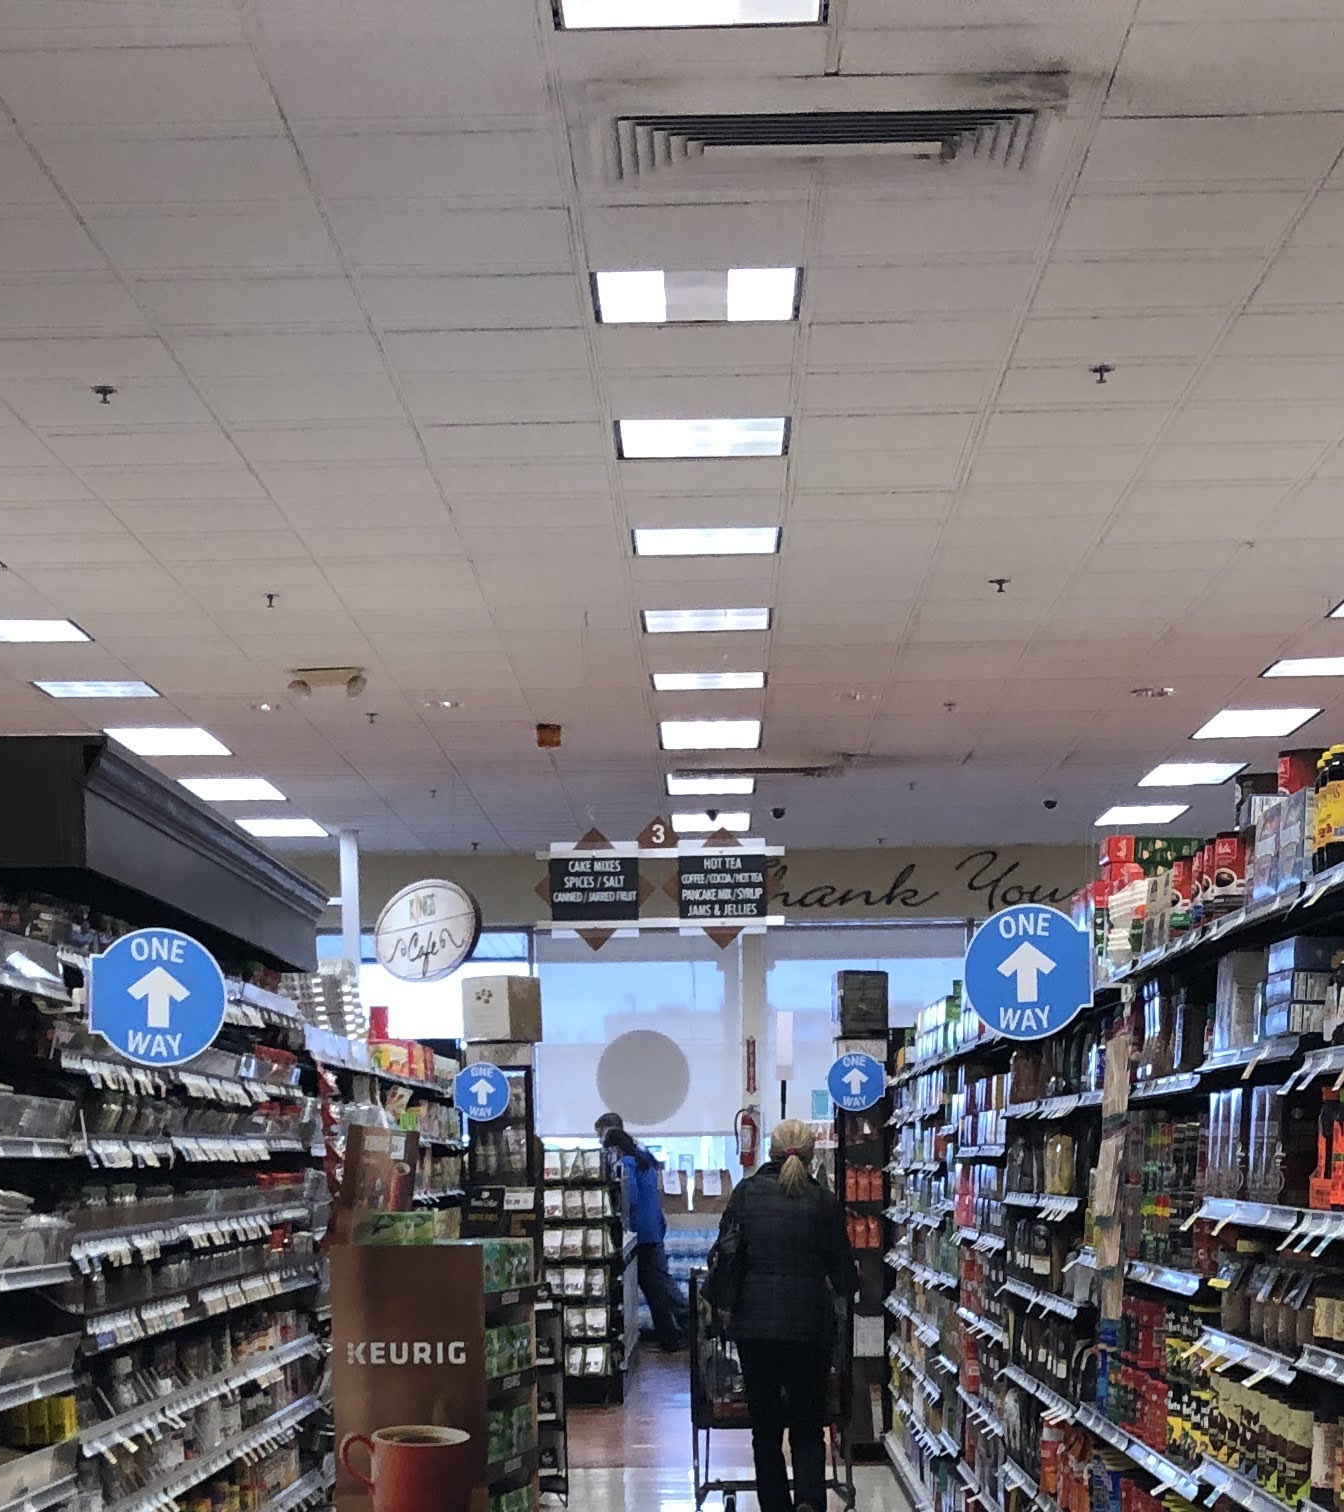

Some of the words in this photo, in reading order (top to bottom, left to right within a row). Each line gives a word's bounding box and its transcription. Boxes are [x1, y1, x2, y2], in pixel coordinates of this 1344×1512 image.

[651, 824, 665, 844] 3
[568, 860, 592, 873] CAKE
[594, 859, 621, 872] MIXES
[703, 858, 724, 870] HOT
[725, 857, 742, 869] TEA
[563, 876, 594, 889] SPICES
[603, 875, 624, 888] SALT
[681, 873, 705, 884] COFFEE
[956, 850, 1078, 913] You
[552, 891, 582, 903] CANNED
[616, 890, 637, 901] FRUIT
[681, 888, 716, 900] PANCAKE
[717, 889, 732, 900] MIX
[737, 887, 763, 899] SYRUP
[687, 904, 712, 917] JAMS
[714, 904, 721, 915] &
[723, 903, 757, 916] JELLIES
[999, 912, 1052, 939] ONE
[130, 936, 188, 964] ONE
[999, 1004, 1051, 1032] WAY
[127, 1028, 183, 1058] WAY
[842, 1055, 867, 1068] ONE
[470, 1066, 495, 1079] ONE
[842, 1095, 867, 1107] WAY
[469, 1105, 493, 1117] WAY
[346, 1341, 467, 1365] KEURIG
